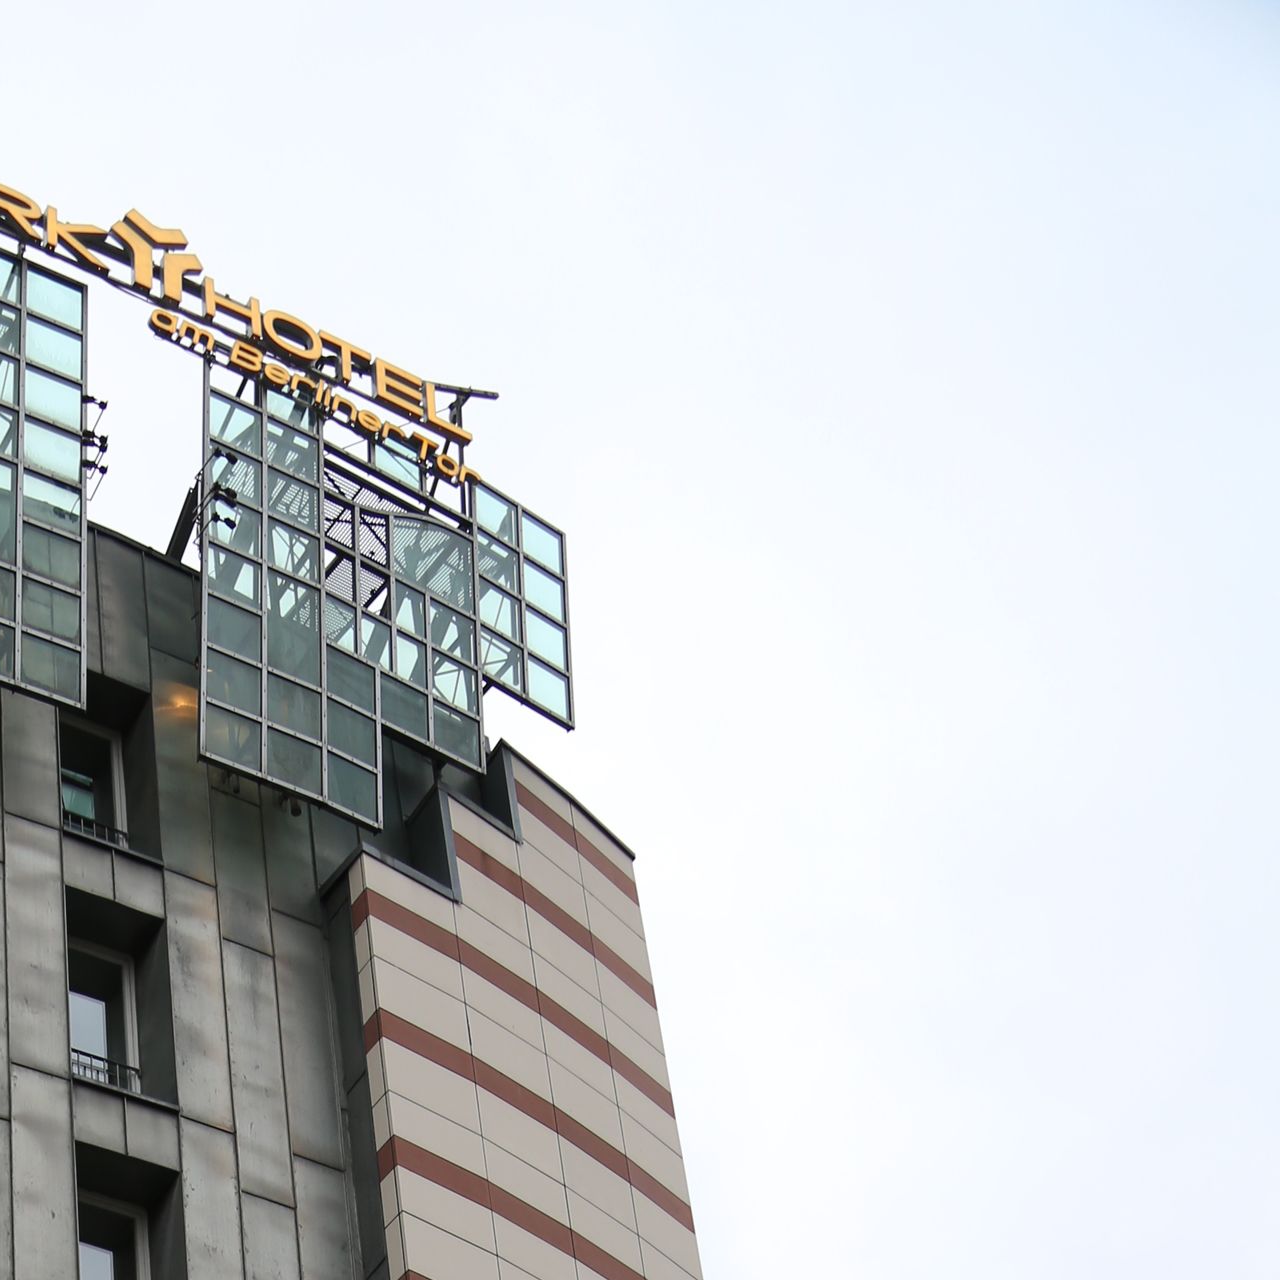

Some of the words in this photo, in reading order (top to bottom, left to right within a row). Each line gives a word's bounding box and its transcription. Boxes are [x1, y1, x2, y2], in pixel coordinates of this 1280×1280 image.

[148, 308, 215, 352] am
[228, 339, 407, 441] Berliner
[411, 431, 481, 484] Tor
[201, 276, 473, 445] HOTEL
